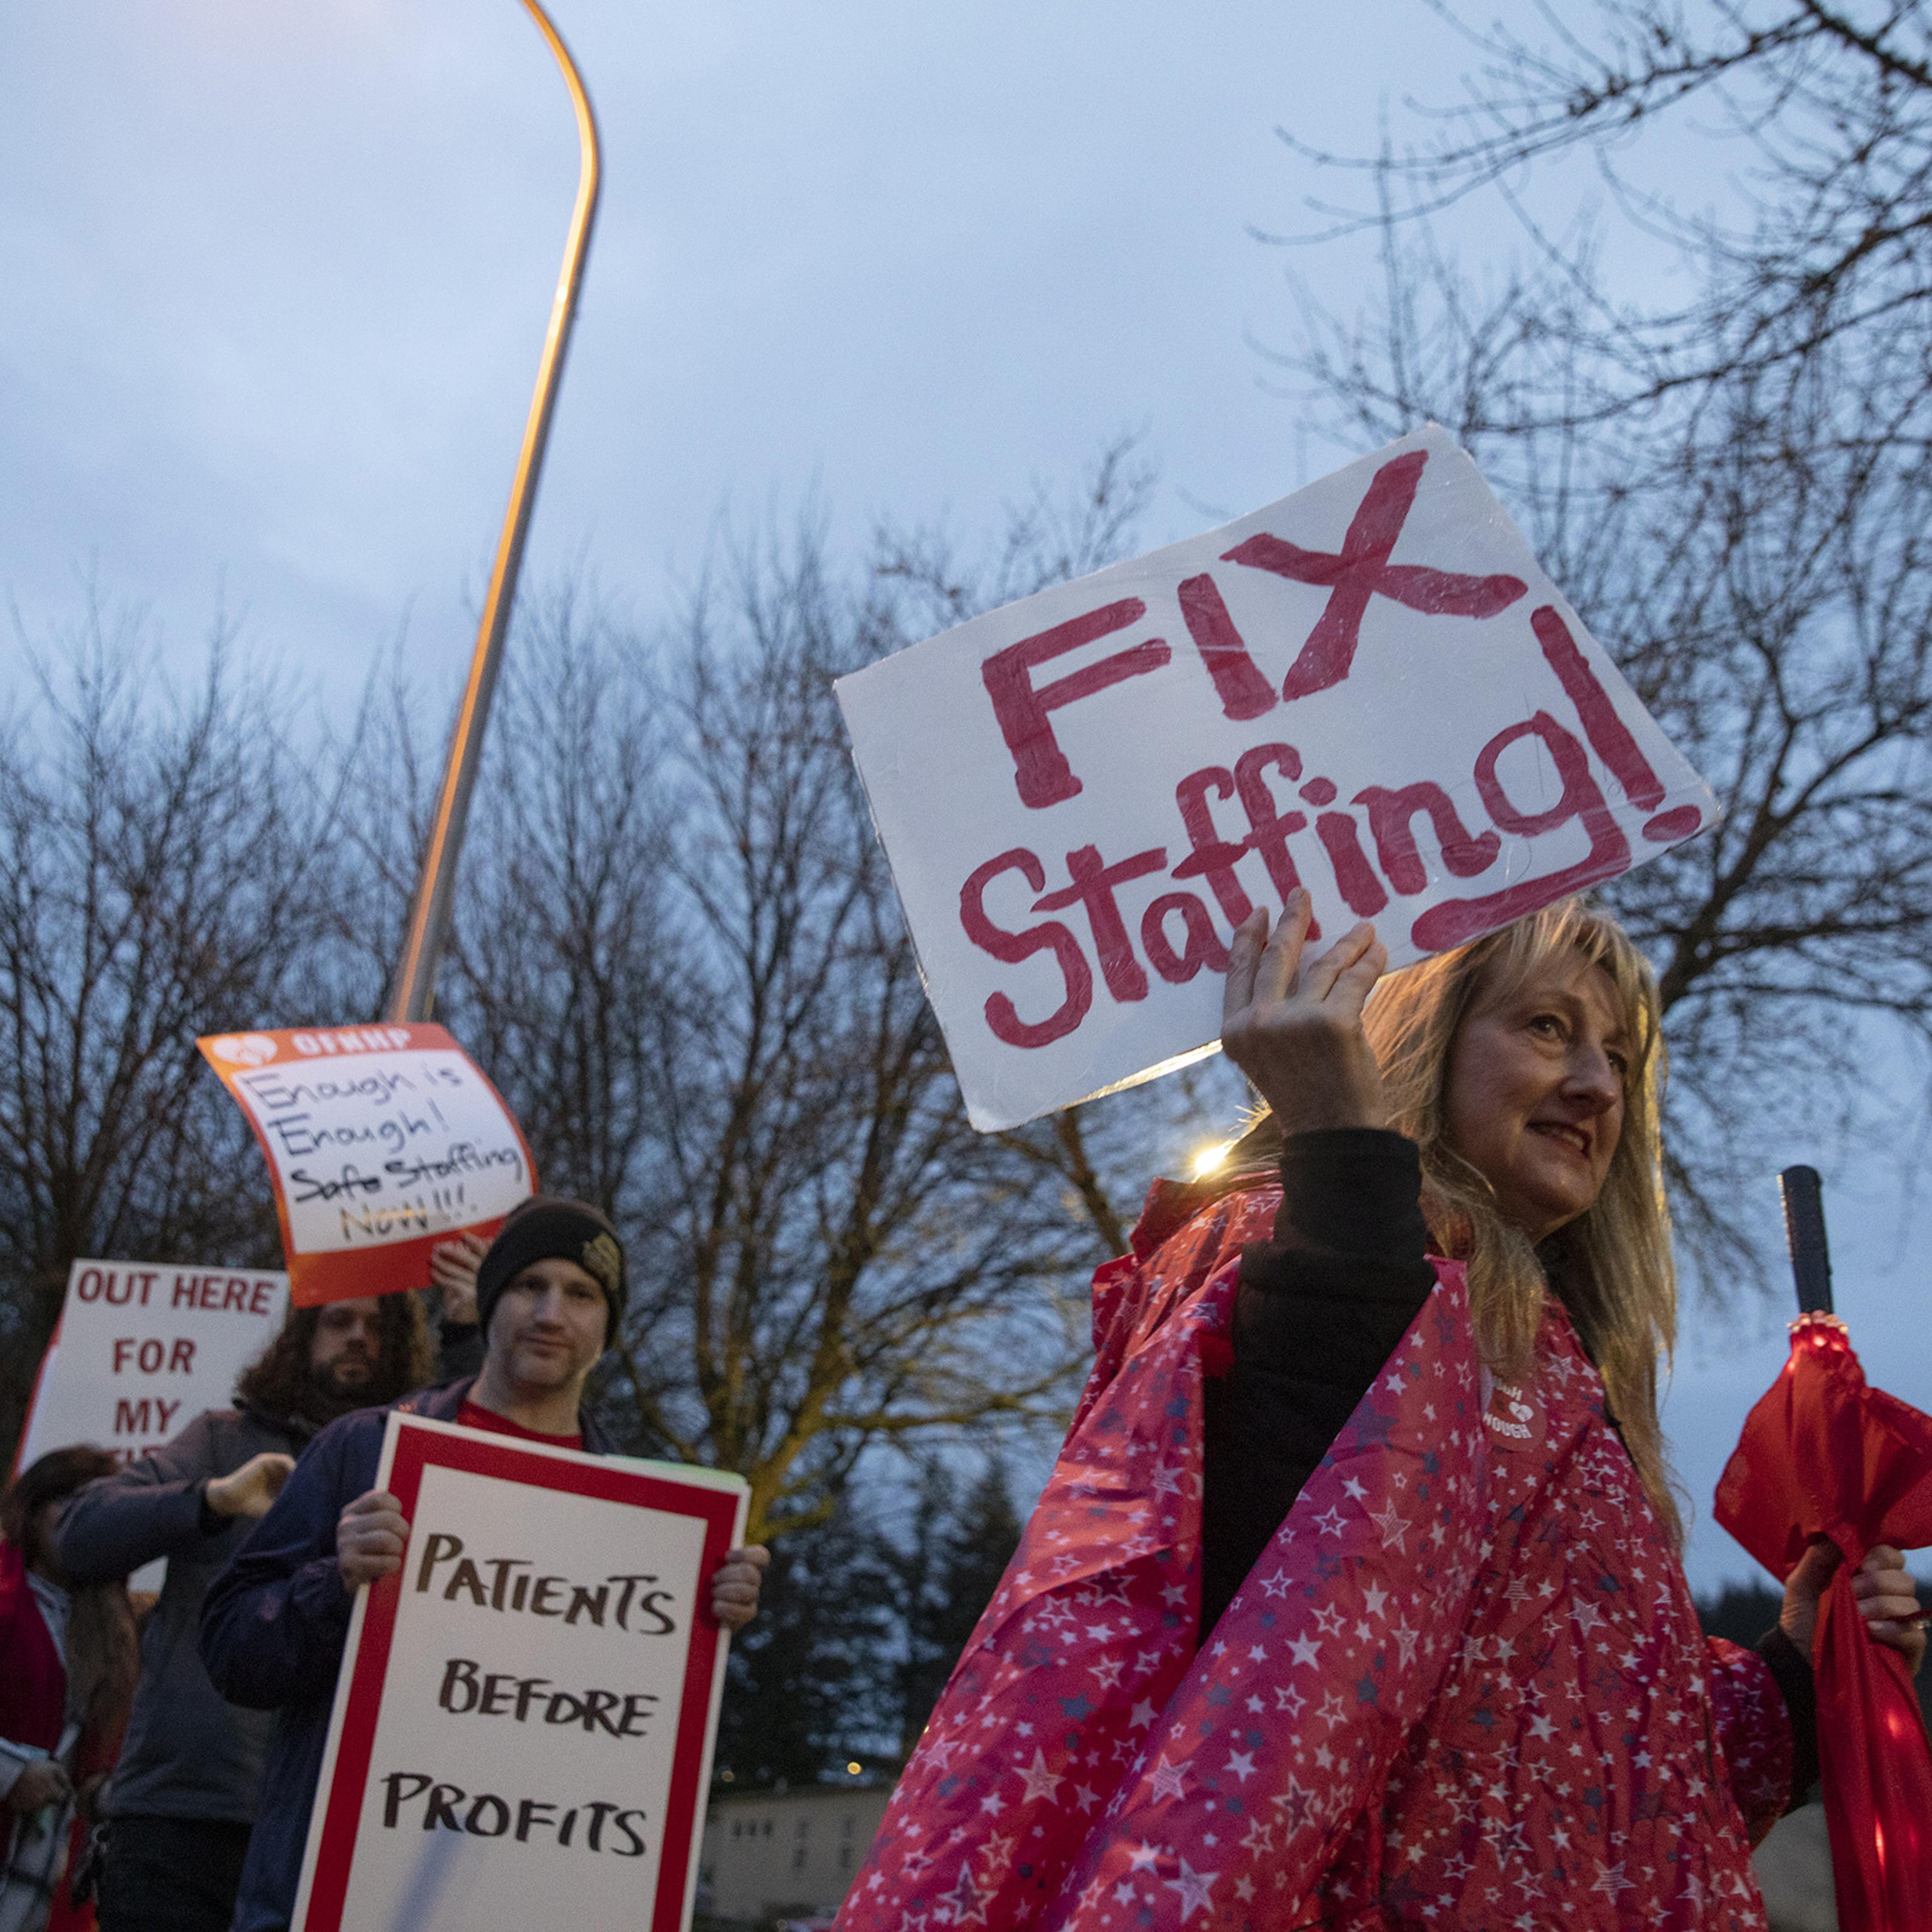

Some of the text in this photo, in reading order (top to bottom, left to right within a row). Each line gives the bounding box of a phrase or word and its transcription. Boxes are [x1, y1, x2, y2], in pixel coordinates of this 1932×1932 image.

[982, 449, 1527, 808] FIX
[959, 605, 1701, 1049] Staffing!
[242, 1068, 416, 1109] Enough
[268, 1099, 449, 1156] Enough!
[291, 1138, 521, 1202] Safe Staffing
[78, 1269, 276, 1315] OUT HERE
[113, 1338, 197, 1375] FOR
[114, 1398, 182, 1434] MY
[416, 1534, 677, 1636] PATIENTS
[439, 1658, 660, 1739] BEFORE
[380, 1772, 647, 1858] PROFITS
